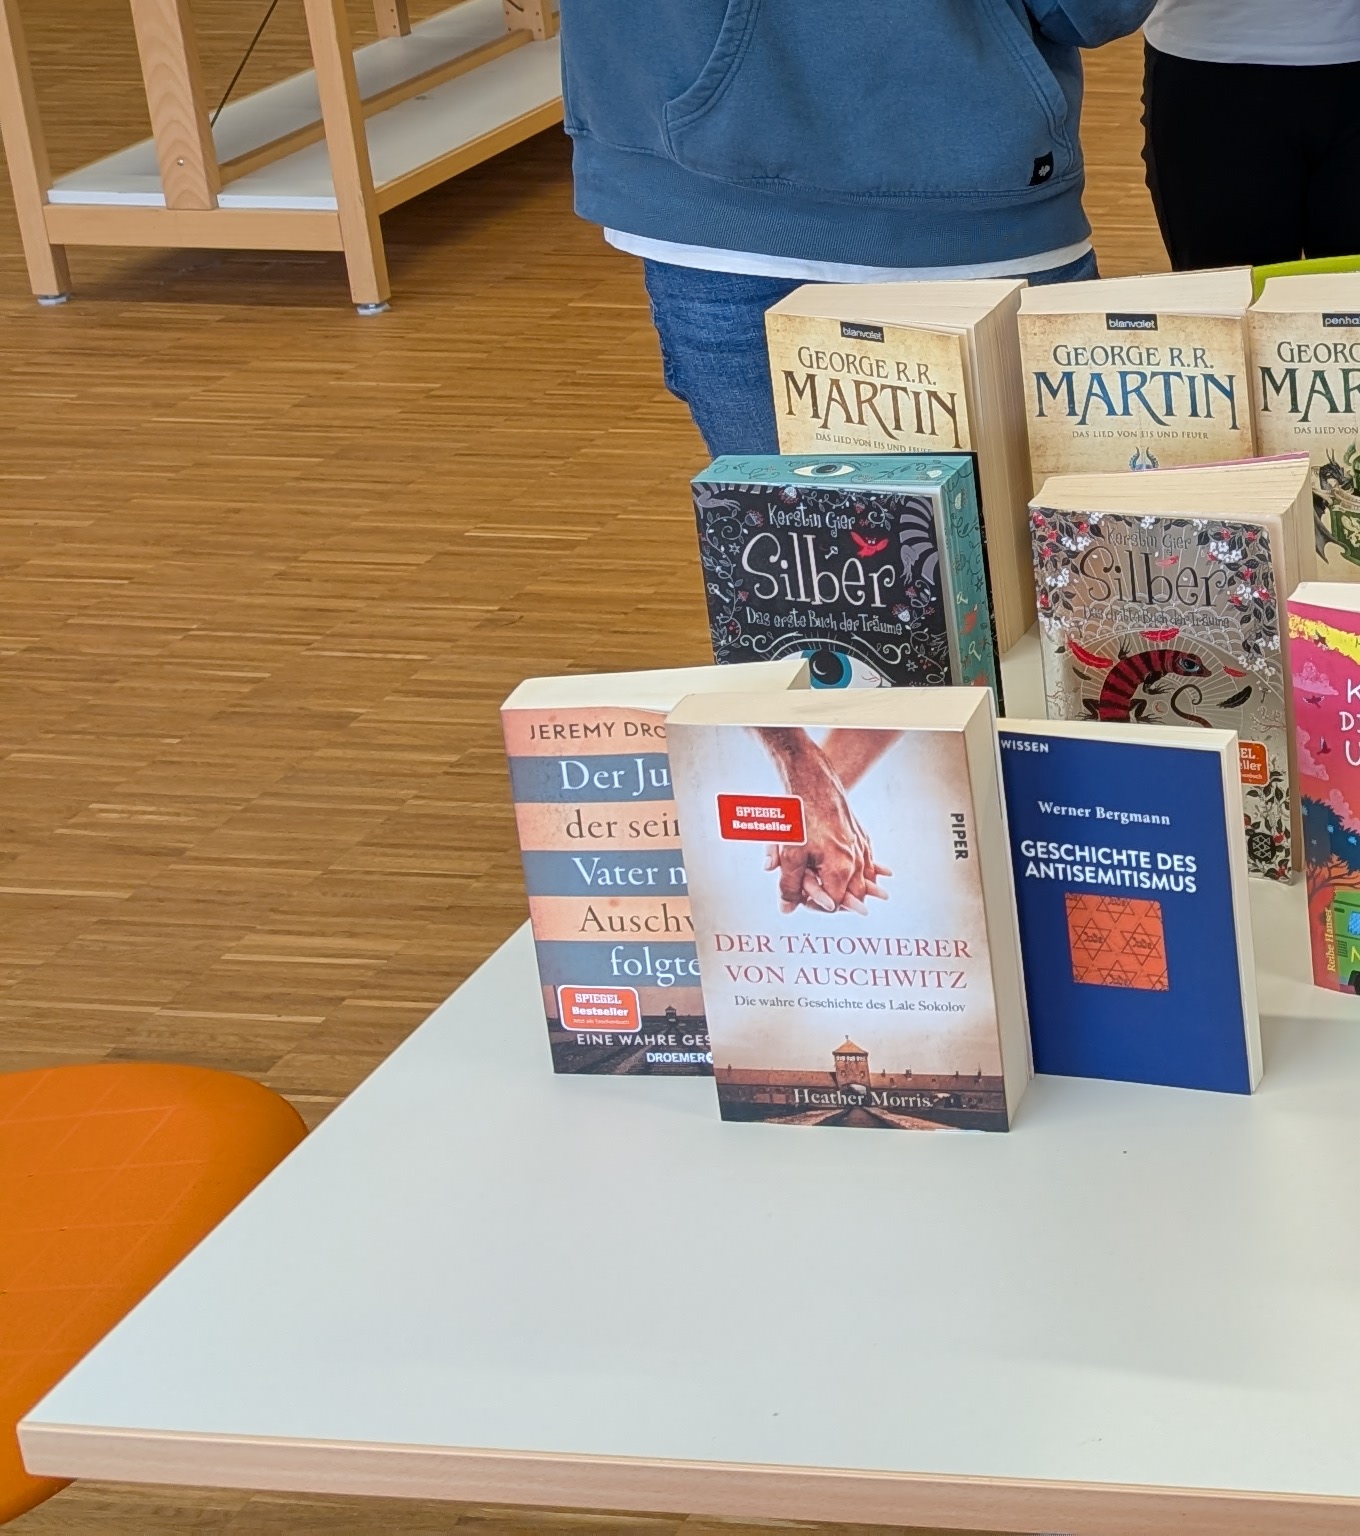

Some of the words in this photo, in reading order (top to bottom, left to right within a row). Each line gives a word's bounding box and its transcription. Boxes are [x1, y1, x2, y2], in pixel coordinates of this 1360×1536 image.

[1052, 345, 1161, 366] GEORGE
[1169, 347, 1214, 369] R.R.
[781, 370, 963, 449] MARTIN
[1031, 370, 1241, 431] MARTIN
[768, 503, 822, 529] Kerstin
[826, 512, 856, 537] Gier
[742, 532, 896, 608] Silber
[746, 606, 771, 627] Das
[773, 608, 808, 628] erste
[809, 610, 837, 631] Buch
[839, 613, 859, 632] der
[858, 614, 903, 635] Träume
[530, 721, 616, 740] JEREMY
[559, 759, 625, 791] Der
[565, 809, 618, 839] der
[732, 820, 793, 832] Bestseller
[1038, 801, 1092, 819] Werner
[1095, 806, 1171, 826] Bergmann
[950, 812, 969, 861] PIPER
[1021, 839, 1151, 869] GESCHICHTE
[1157, 853, 1197, 873] DES
[571, 857, 659, 886] Vater
[1024, 861, 1197, 893] ANTISEMITISMUS
[714, 934, 775, 953] DER
[779, 932, 973, 959] TÄTOWIERER
[725, 965, 789, 985] VON
[794, 967, 968, 990] AUSCHWITZ
[734, 995, 756, 1008] Die
[758, 996, 795, 1008] wahre
[798, 997, 864, 1010] Geschichte
[866, 998, 886, 1010] des
[889, 999, 915, 1011] Lale
[918, 1000, 967, 1013] Sokolov
[793, 1088, 865, 1107] Heather
[871, 1091, 931, 1108] Morris
